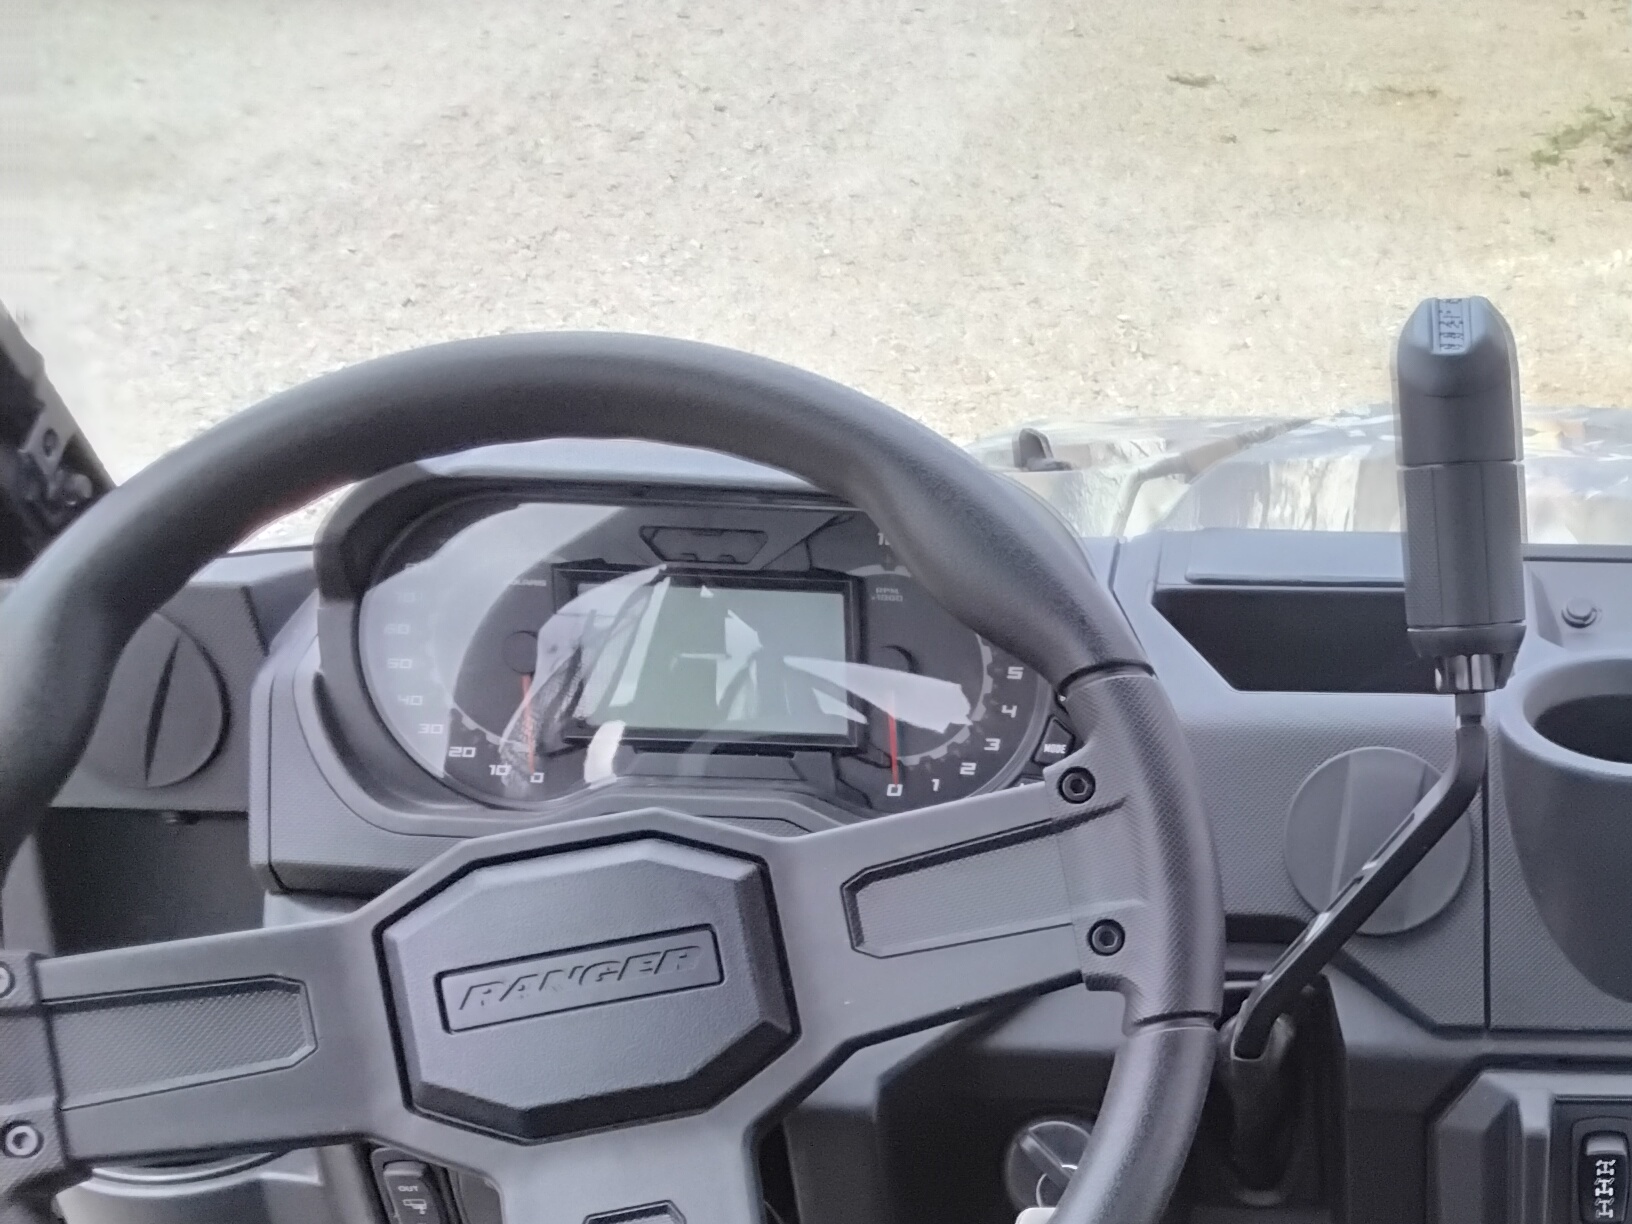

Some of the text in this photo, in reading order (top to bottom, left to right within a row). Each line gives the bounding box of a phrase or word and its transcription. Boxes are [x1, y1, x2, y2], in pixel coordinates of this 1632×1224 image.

[387, 658, 413, 669] 50
[1007, 667, 1024, 680] 5
[398, 695, 423, 706] 40
[1001, 705, 1018, 718] 4
[418, 723, 444, 735] 30
[984, 738, 1001, 752] 3
[1044, 743, 1067, 754] MODE
[449, 746, 477, 758] 20
[489, 764, 512, 776] 10
[959, 762, 977, 776] 2
[530, 772, 545, 784] 0
[886, 783, 903, 797] 0
[931, 779, 940, 792] 1
[459, 945, 701, 1012] RANGER
